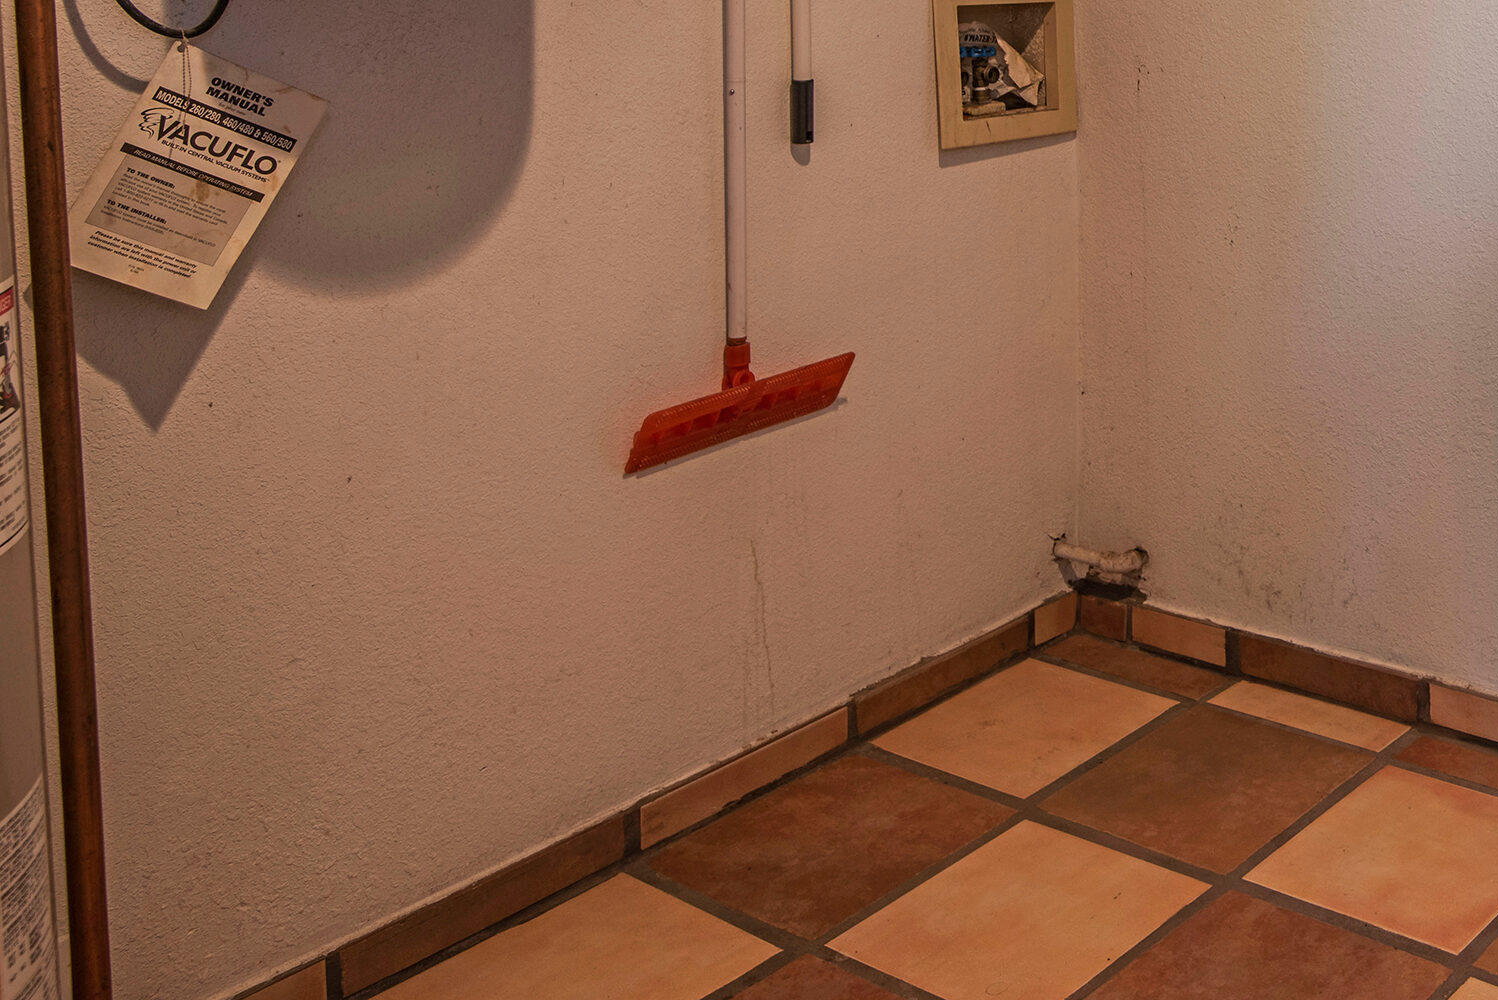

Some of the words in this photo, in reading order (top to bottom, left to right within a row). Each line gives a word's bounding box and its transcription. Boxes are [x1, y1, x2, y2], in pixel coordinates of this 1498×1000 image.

[206, 87, 265, 116] MANUAL
[211, 77, 274, 107] OWNER'S
[156, 90, 190, 109] MODELS
[189, 104, 220, 124] 260/280,
[223, 116, 254, 134] 460/480
[254, 130, 261, 138] &
[261, 132, 292, 150] 560/580
[157, 114, 277, 174] VACUFLO
[152, 154, 176, 168] MANUAL
[176, 164, 198, 176] BEFORE
[162, 140, 186, 153] BUILT-IN
[188, 149, 214, 164] CENTRAL
[215, 161, 240, 174] VACUUM
[240, 170, 267, 183] SYSTEMS
[137, 171, 149, 179] THE
[151, 175, 176, 189] OWNER:
[117, 203, 129, 211] THE
[130, 207, 167, 224] INSTALLER:
